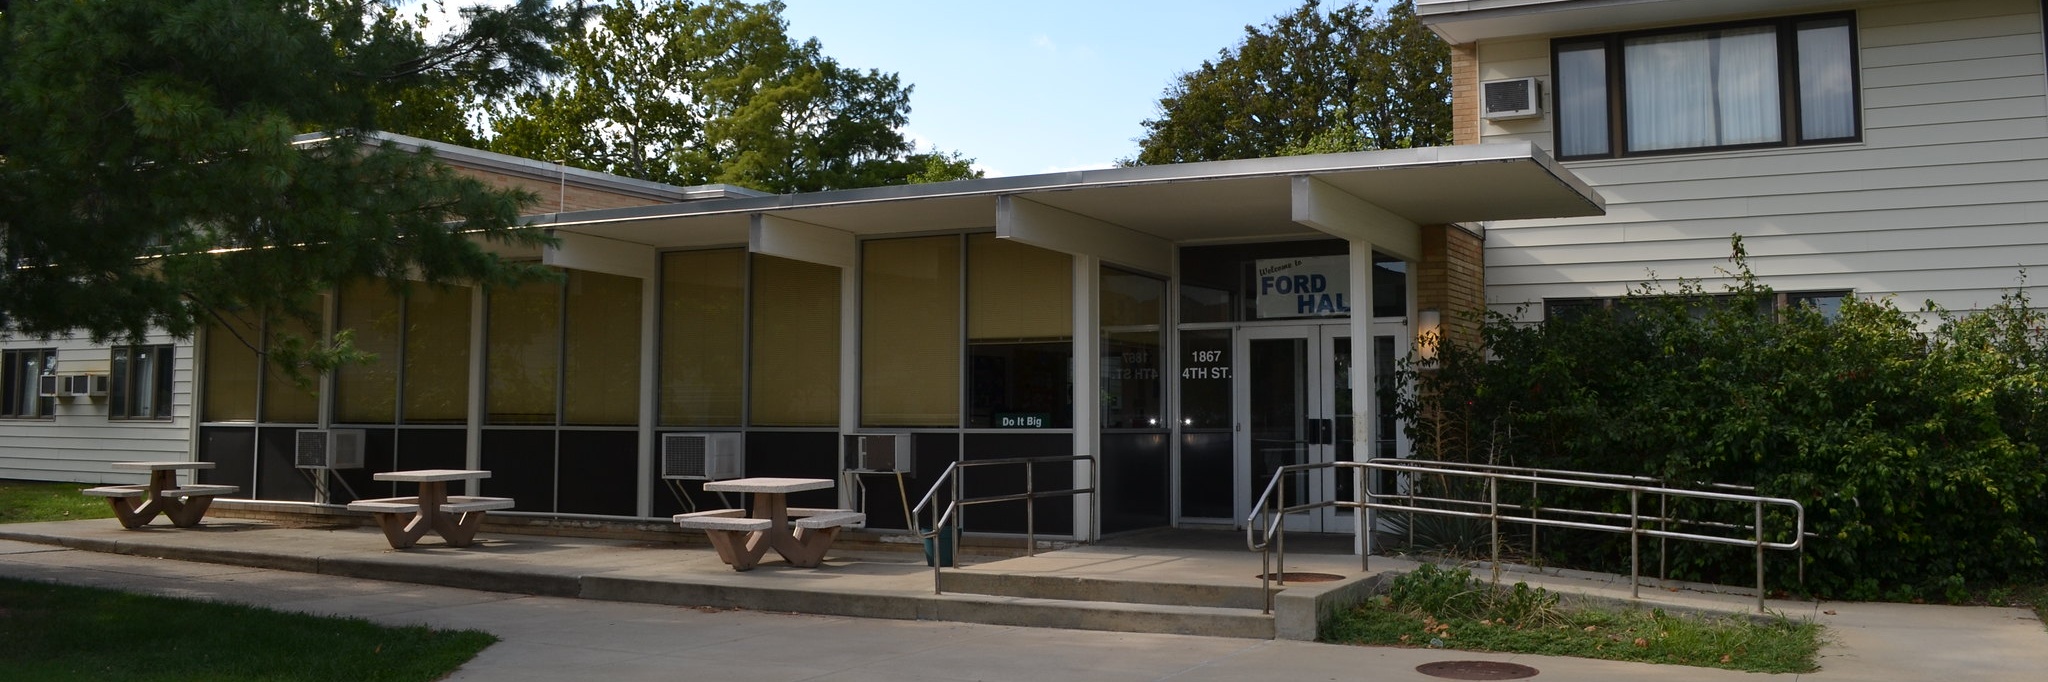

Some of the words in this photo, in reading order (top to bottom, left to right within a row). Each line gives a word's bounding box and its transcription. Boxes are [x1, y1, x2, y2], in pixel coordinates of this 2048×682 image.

[1259, 263, 1292, 276] Welcome
[1262, 274, 1327, 295] FORD
[1297, 293, 1351, 314] HAL
[1192, 350, 1222, 363] 1867
[1182, 367, 1207, 379] 4TH
[1211, 367, 1232, 379] ST.
[1002, 417, 1015, 426] Do
[1017, 417, 1025, 426] It
[1027, 416, 1042, 428] Big
